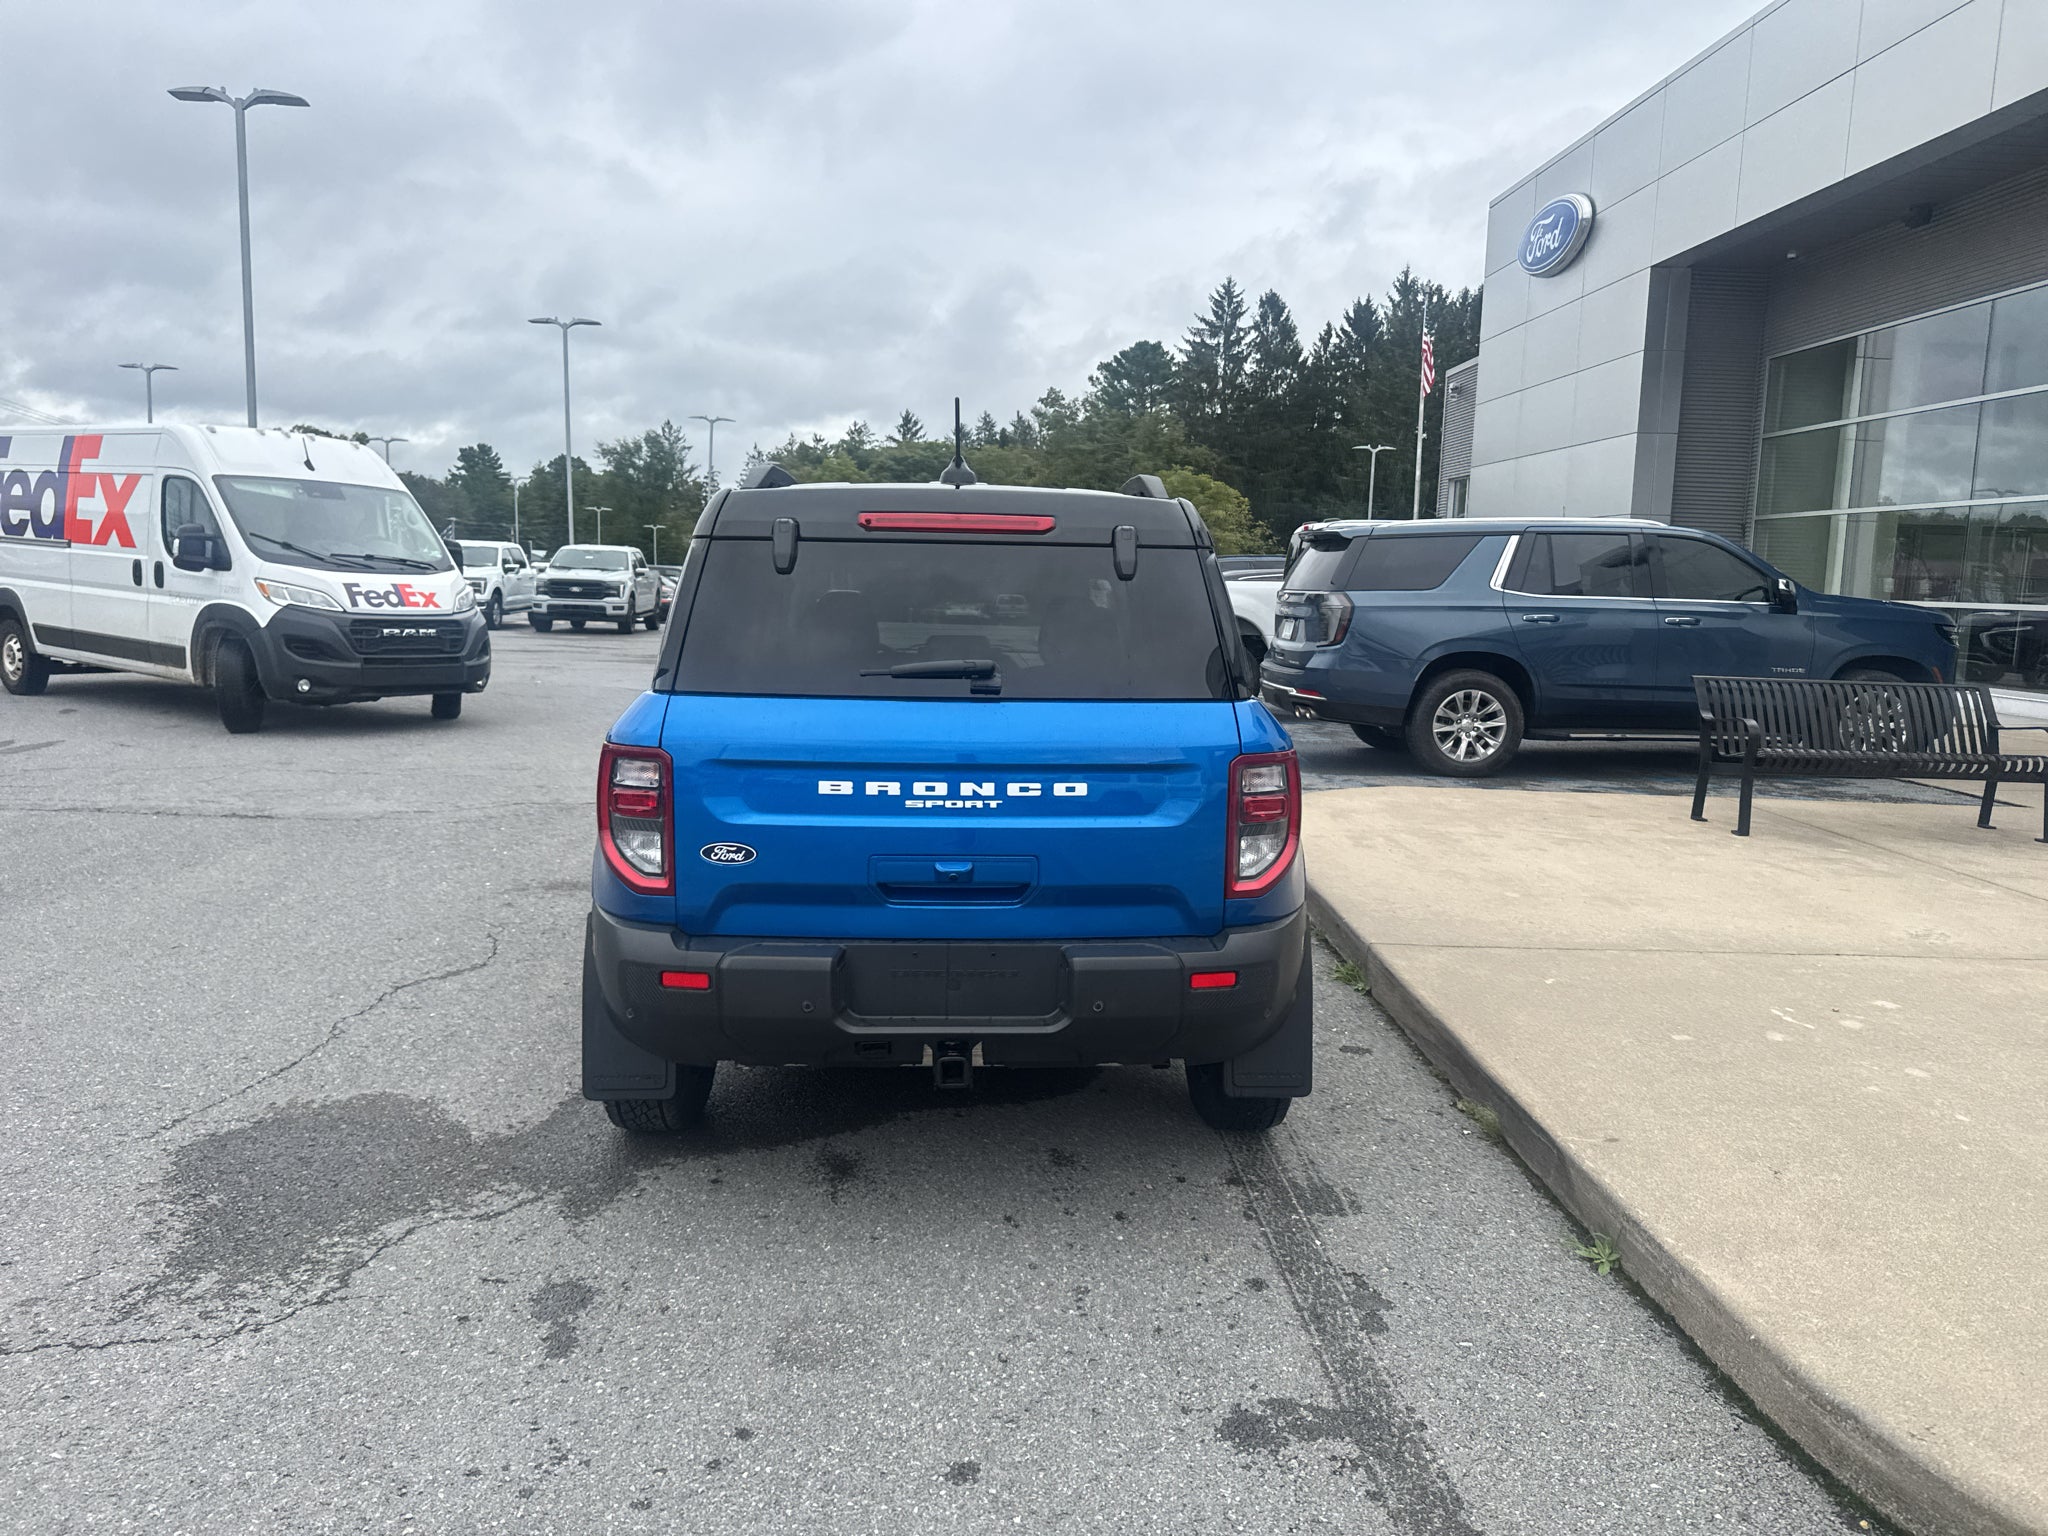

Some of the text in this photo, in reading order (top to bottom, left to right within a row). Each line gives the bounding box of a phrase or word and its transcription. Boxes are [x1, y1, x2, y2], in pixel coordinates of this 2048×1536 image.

[1526, 213, 1564, 263] Ford
[342, 583, 442, 608] FedEx
[383, 628, 437, 637] RAM
[818, 780, 1088, 797] BRONCO
[904, 799, 1003, 809] SPORT
